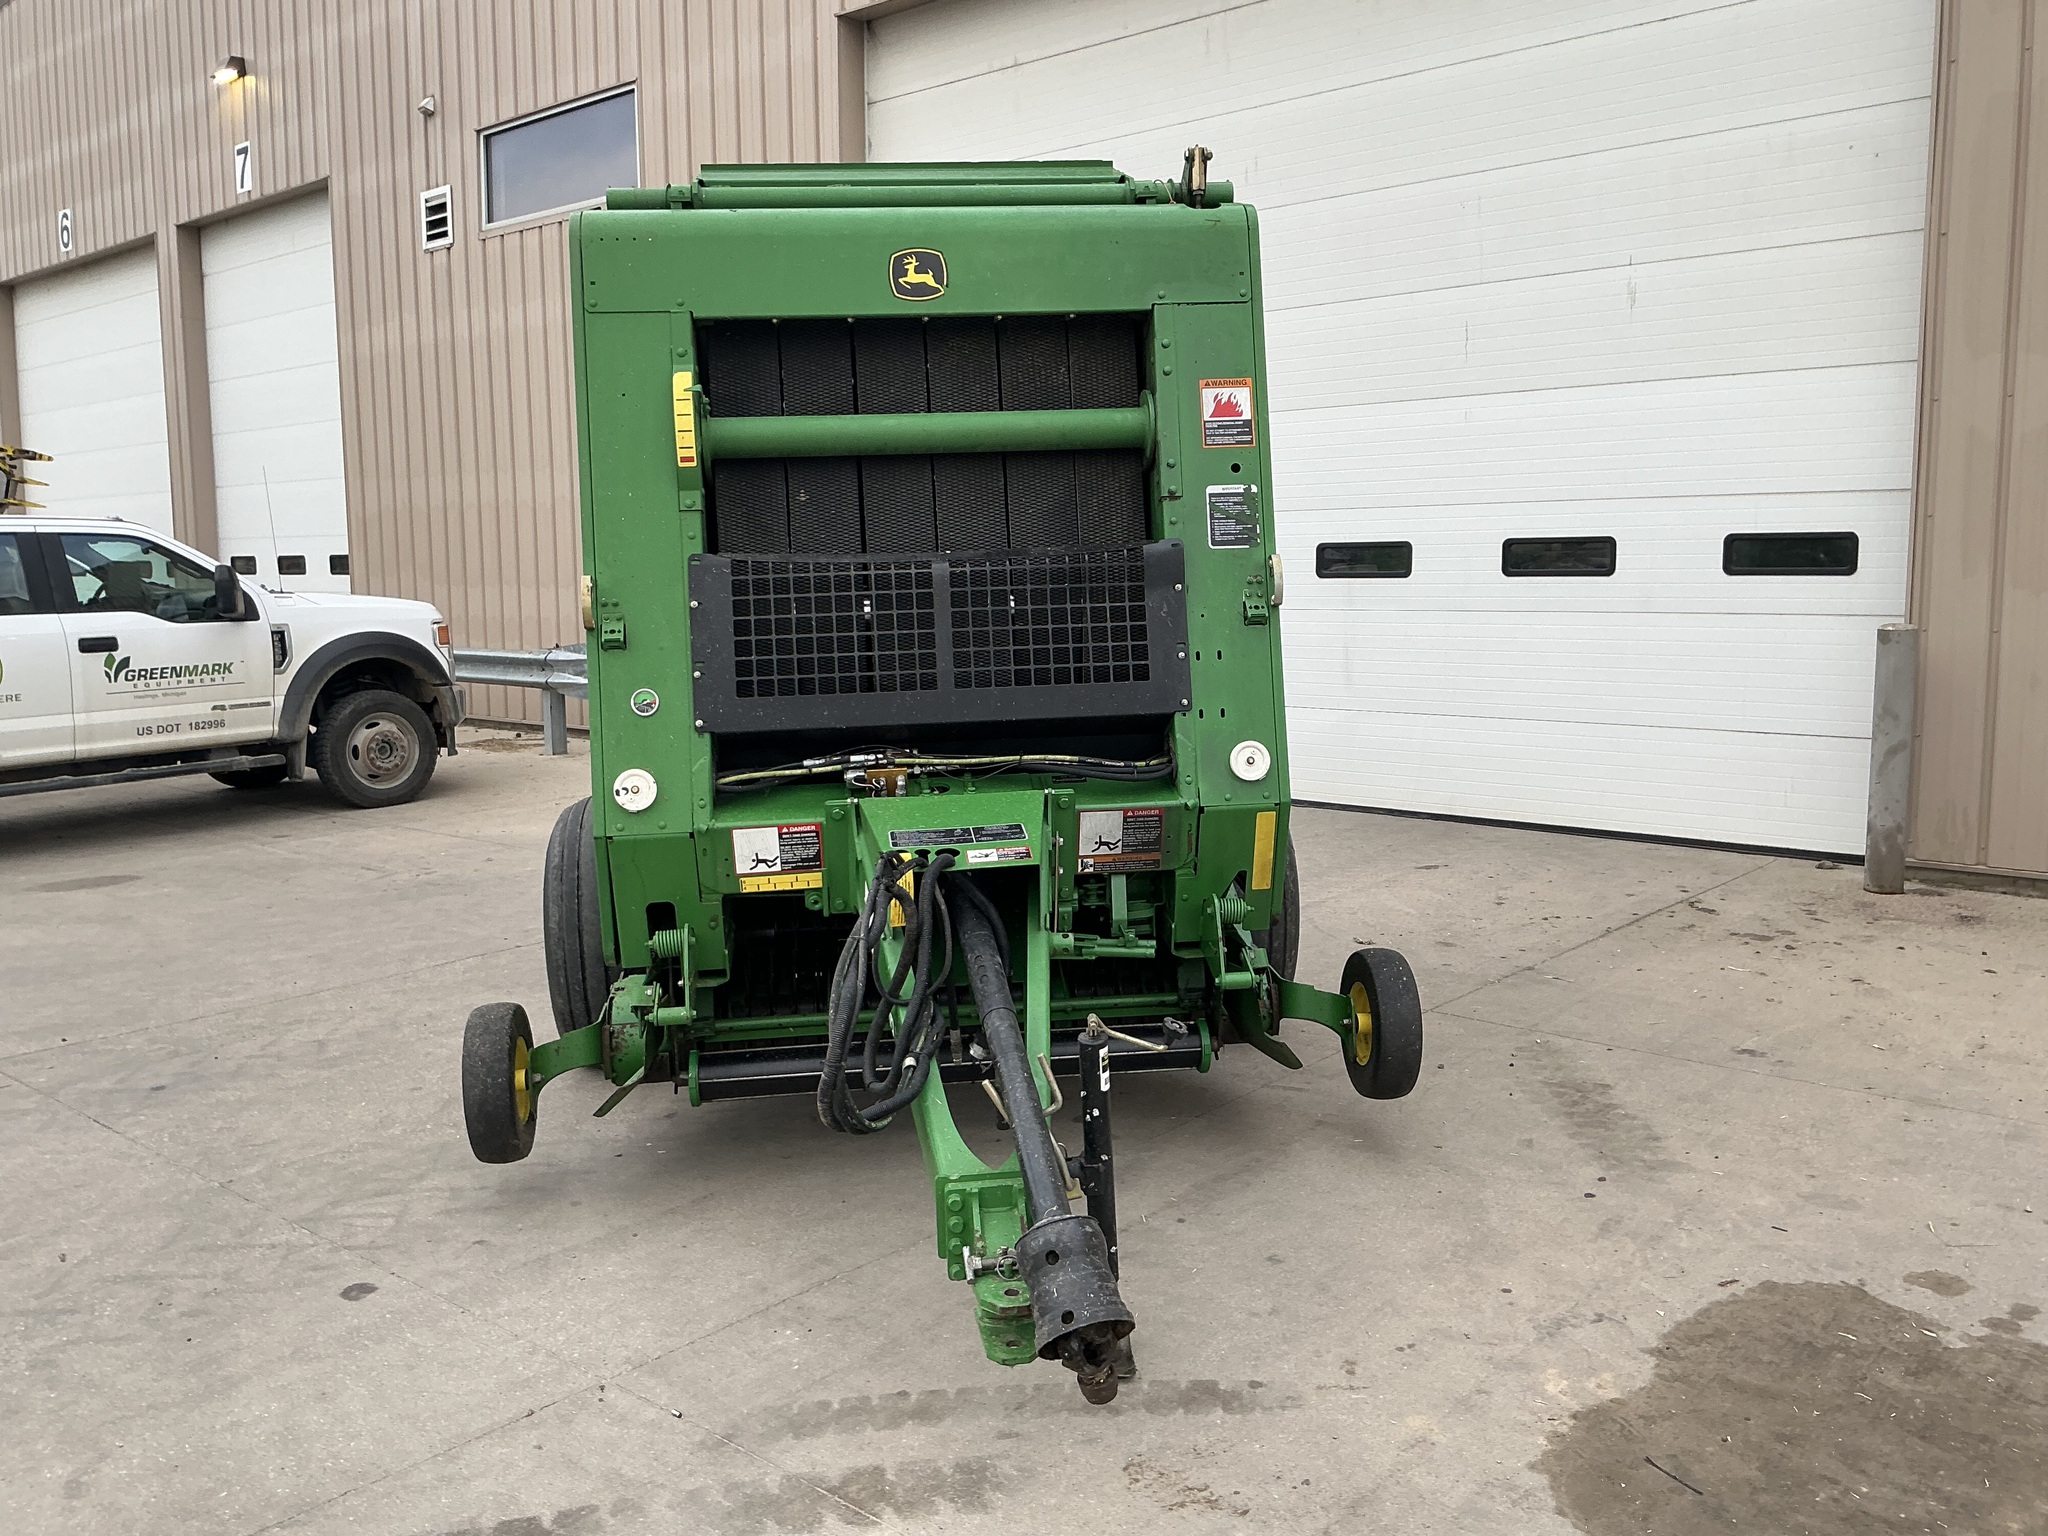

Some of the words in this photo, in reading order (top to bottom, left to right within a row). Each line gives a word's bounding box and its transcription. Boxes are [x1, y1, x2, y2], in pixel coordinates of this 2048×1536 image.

[236, 145, 249, 189] 7
[60, 212, 70, 249] 6
[124, 662, 234, 682] GREENMARK
[133, 676, 226, 689] EQUIPMENT
[137, 726, 153, 736] US
[157, 723, 182, 734] DOT
[188, 719, 226, 731] 182996
